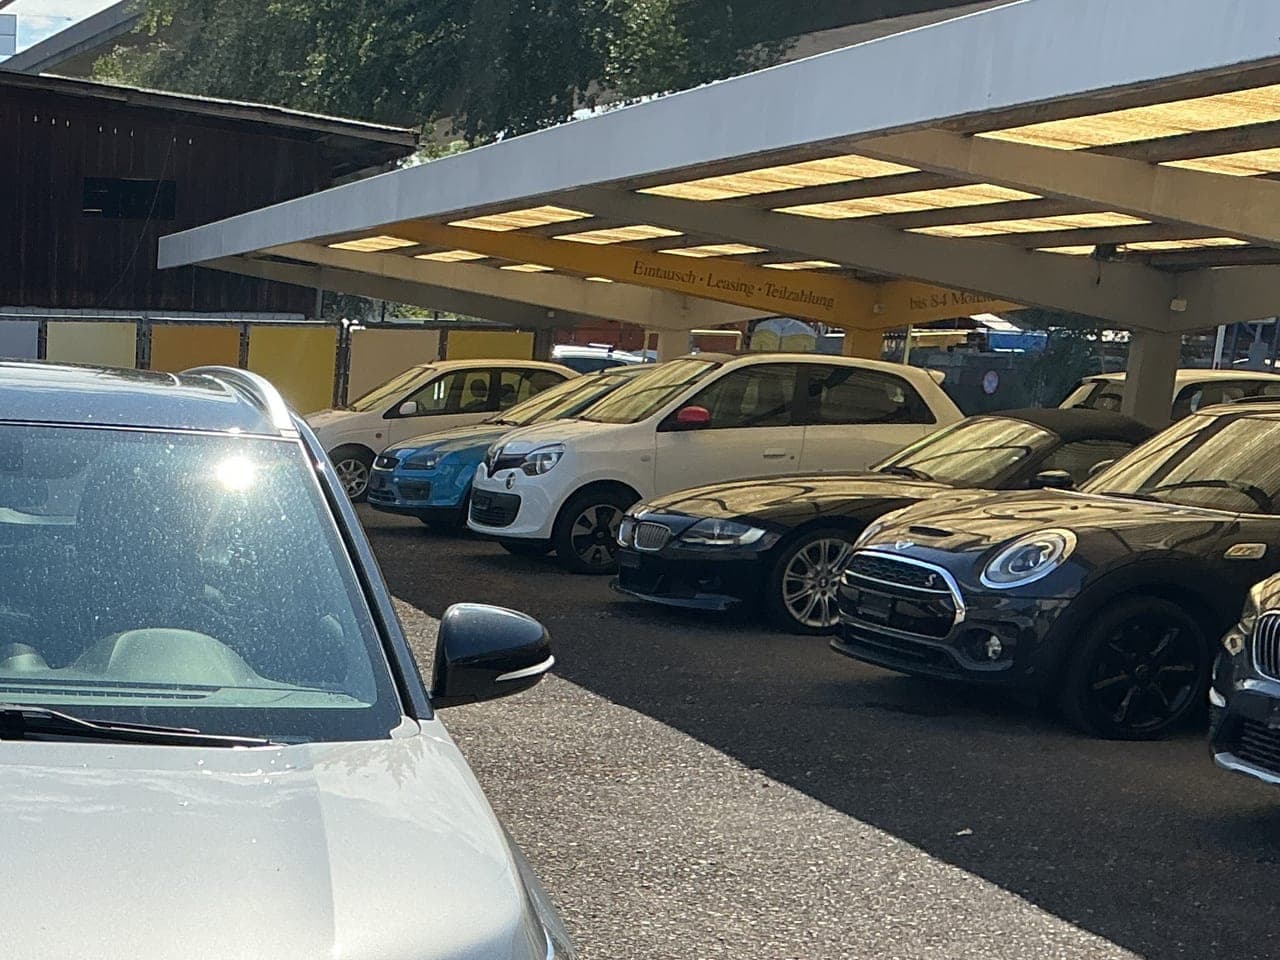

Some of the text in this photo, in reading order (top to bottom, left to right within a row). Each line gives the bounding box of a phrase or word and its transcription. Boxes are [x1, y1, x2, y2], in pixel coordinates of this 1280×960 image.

[633, 260, 835, 310] Eintausch Leasing Teilzahlung
